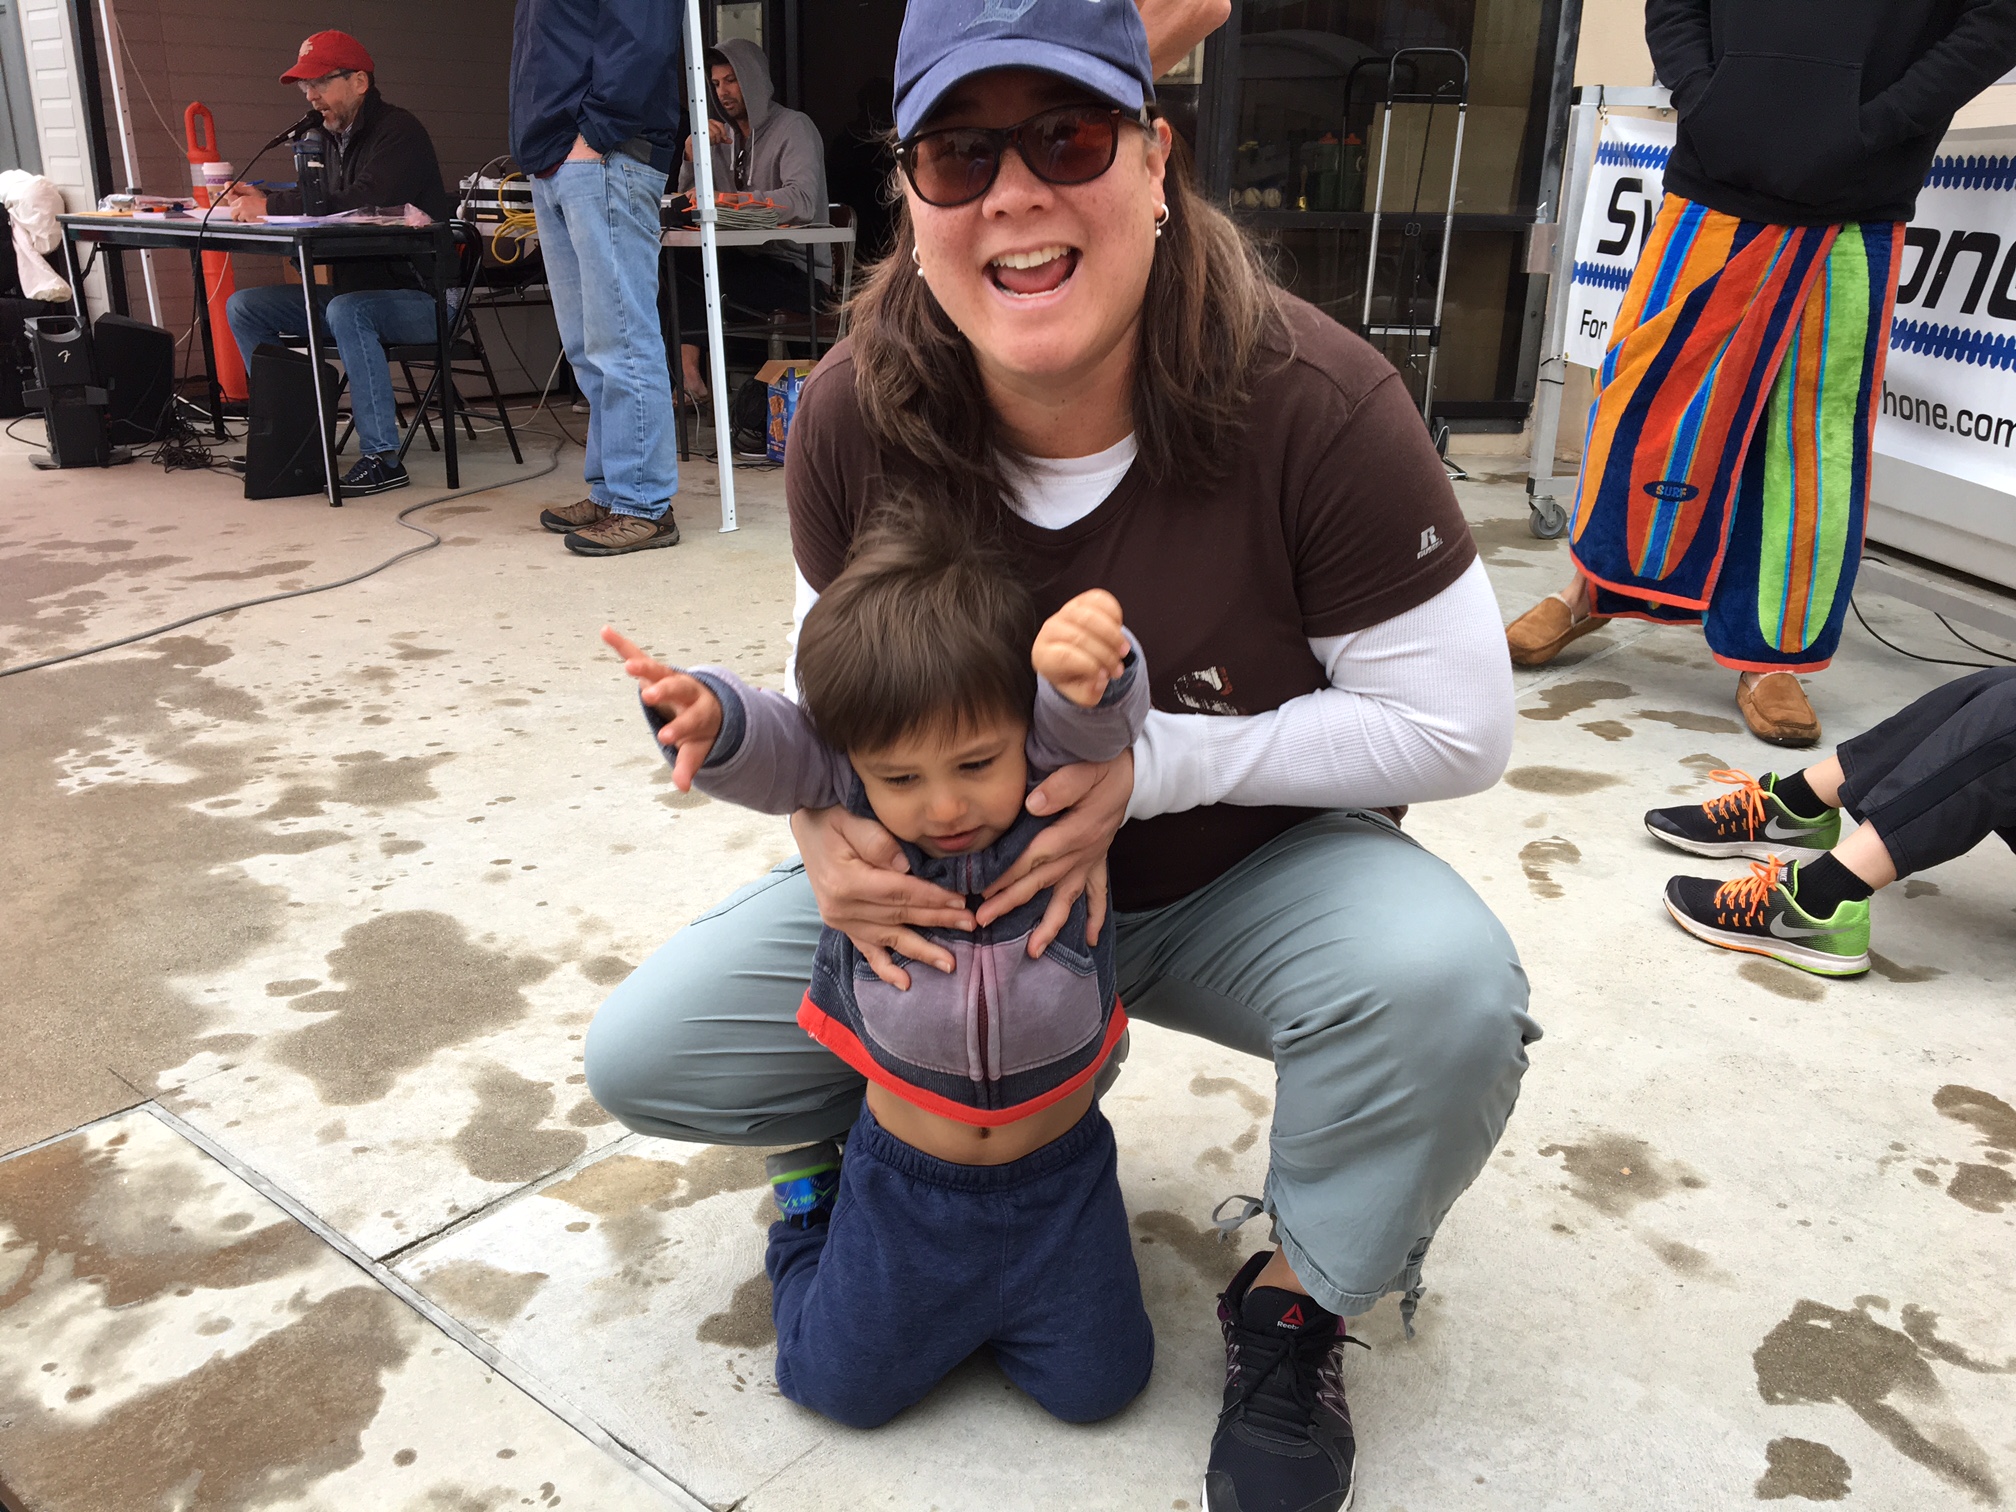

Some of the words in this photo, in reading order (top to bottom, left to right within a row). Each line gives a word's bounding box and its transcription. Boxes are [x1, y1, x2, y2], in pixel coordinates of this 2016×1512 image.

[1580, 309, 1608, 340] For
[1881, 380, 2016, 448] hone.com
[1655, 484, 1688, 499] SURF
